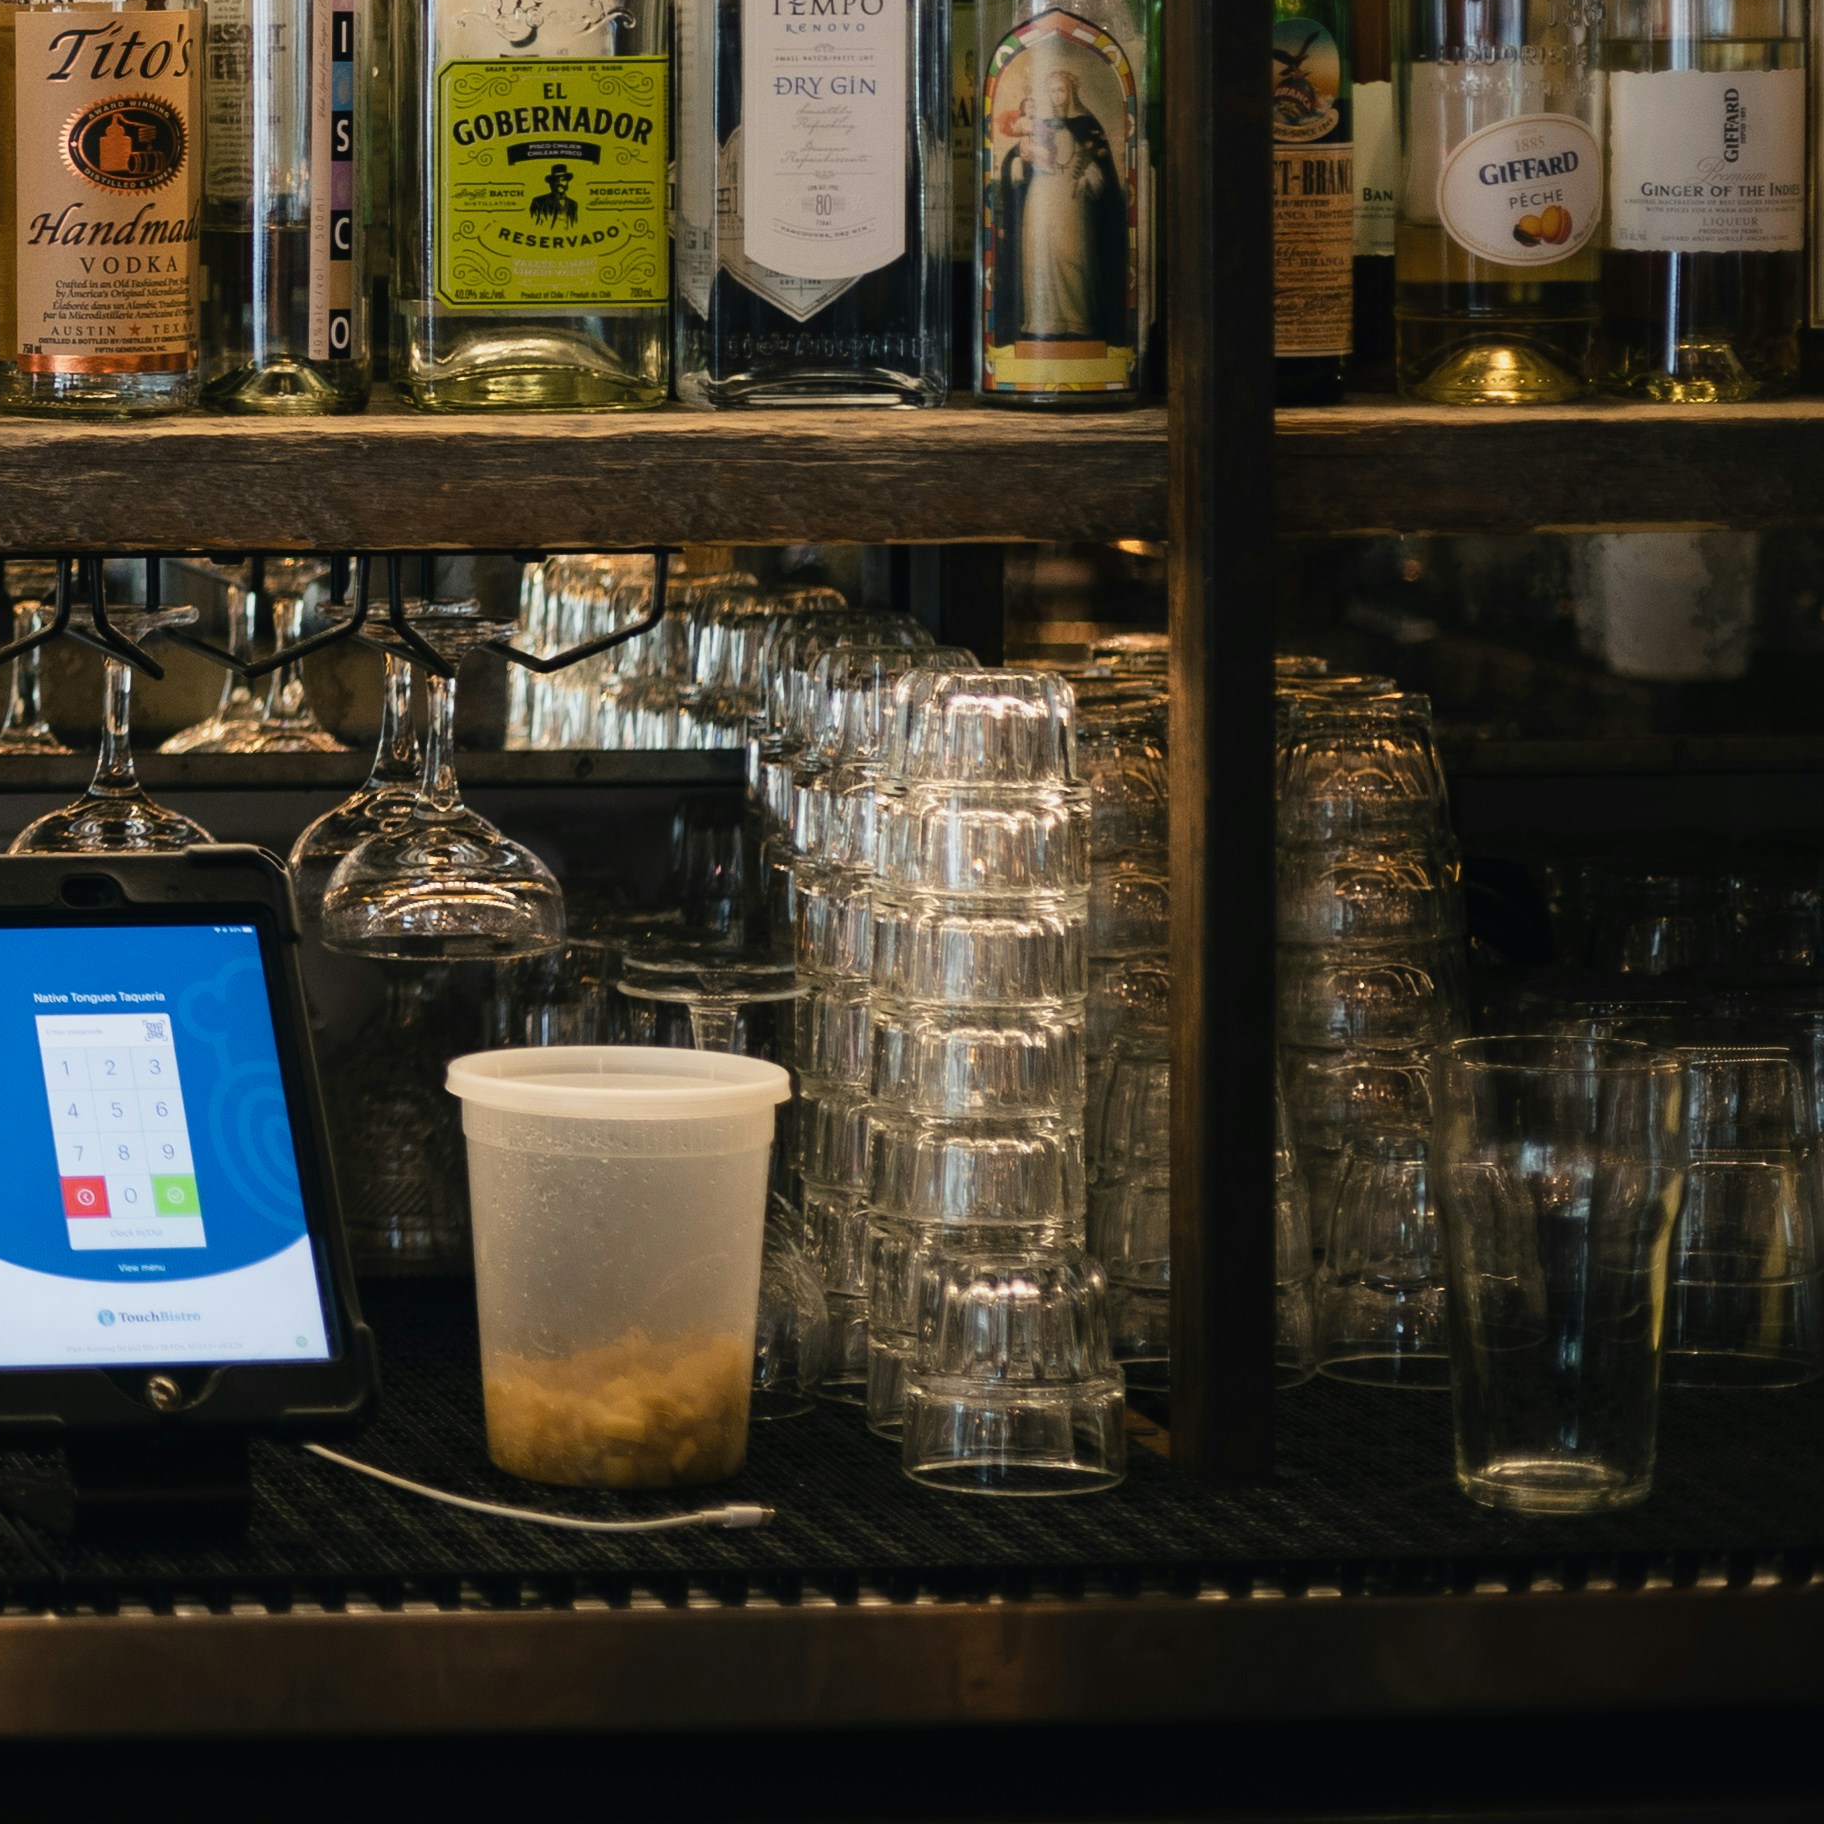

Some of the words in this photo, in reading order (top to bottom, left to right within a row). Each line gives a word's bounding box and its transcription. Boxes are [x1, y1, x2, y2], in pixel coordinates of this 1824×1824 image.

[47, 20, 194, 81] Tito's
[543, 83, 567, 99] EL
[774, 76, 822, 100] DRY
[830, 76, 877, 96] GIN
[453, 105, 653, 145] GOBERNADOR
[1724, 88, 1739, 163] GIFFARD
[1479, 150, 1580, 188] GIFFARD
[1508, 188, 1565, 210] PÊCHE
[498, 226, 619, 248] RESERVADO
[80, 256, 178, 274] VODKA
[51, 325, 116, 337] AUSTIN
[33, 992, 68, 1004] Native
[71, 992, 117, 1005] Tongues
[119, 991, 165, 1004] Taqueria
[118, 1310, 201, 1324] TouchBistro
